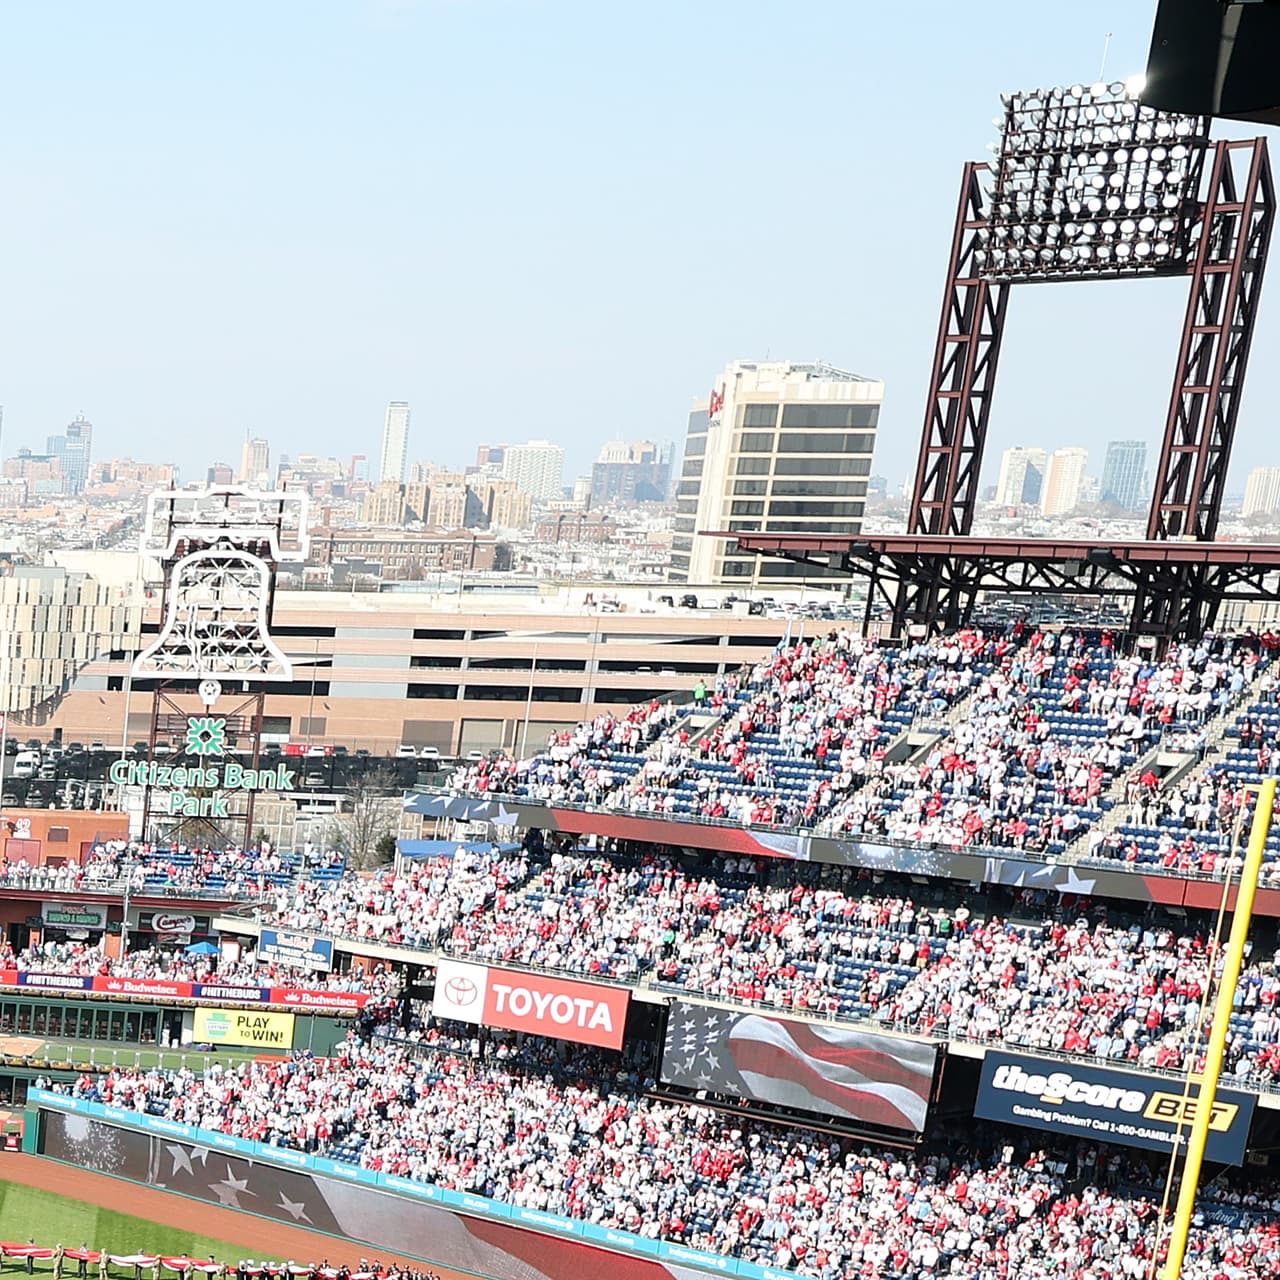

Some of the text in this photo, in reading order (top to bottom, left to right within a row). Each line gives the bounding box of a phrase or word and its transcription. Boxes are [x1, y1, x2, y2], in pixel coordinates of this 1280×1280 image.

[110, 760, 296, 791] Citizens Bank
[169, 793, 229, 818] Park
[26, 975, 84, 988] #HITTHEBUDS
[123, 982, 178, 995] Budweiser
[201, 985, 261, 1000] #HITTHEBUDS
[302, 993, 358, 1007] Budweiser
[237, 1016, 269, 1029] PLAY
[491, 983, 613, 1033] TOYOTA
[252, 1030, 283, 1043] WIN!
[992, 1065, 1146, 1113] theScore
[1013, 1104, 1052, 1122] Gambling
[1053, 1111, 1091, 1128] Problem?
[1092, 1118, 1109, 1132] Call
